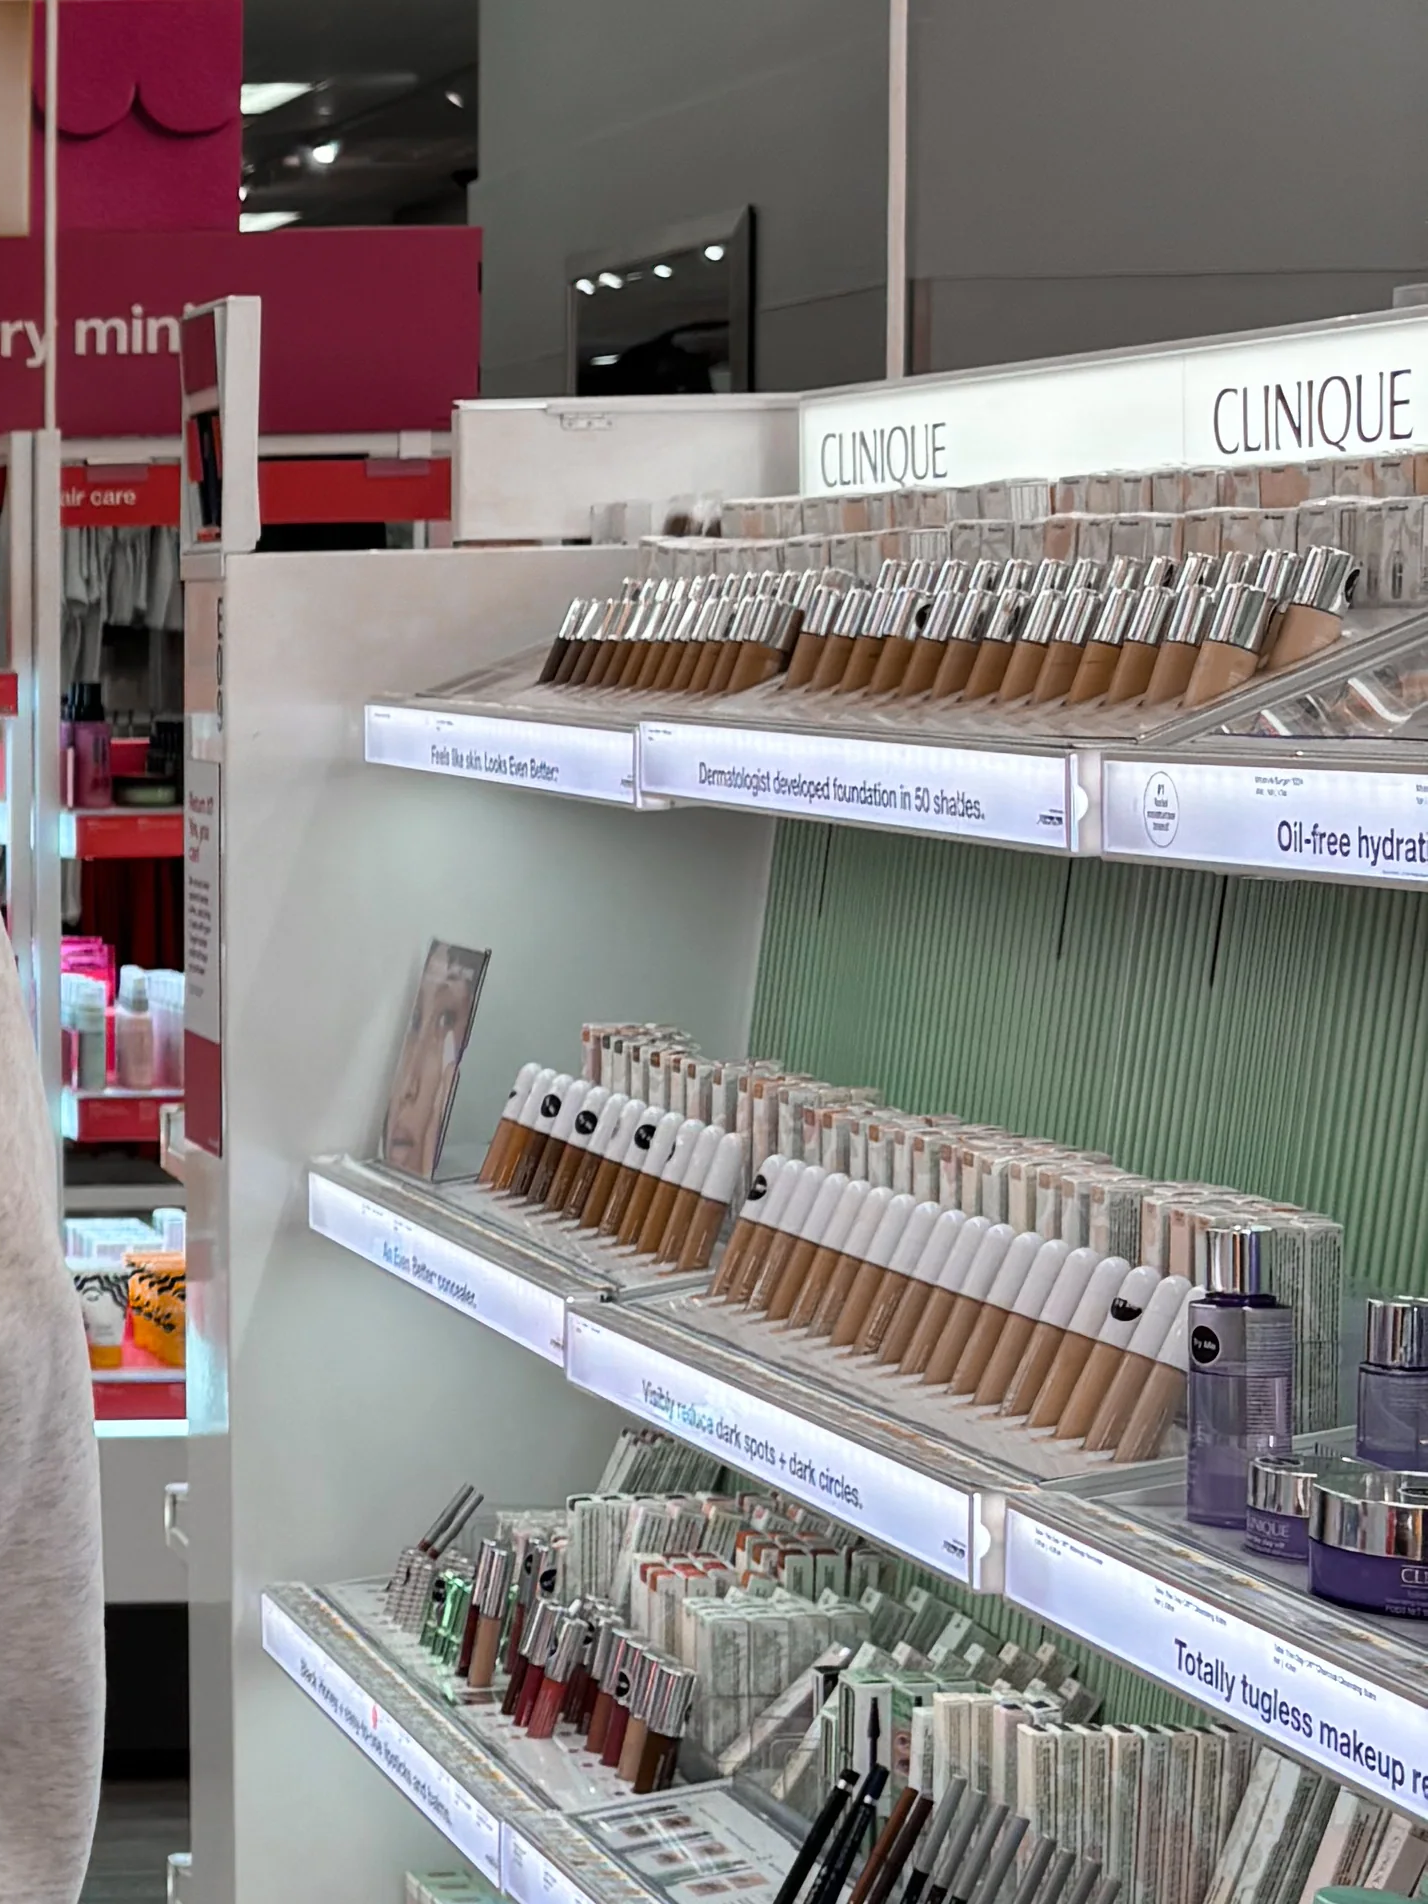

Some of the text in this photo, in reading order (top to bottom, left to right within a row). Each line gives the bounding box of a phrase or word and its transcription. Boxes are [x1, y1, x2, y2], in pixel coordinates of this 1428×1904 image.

[1213, 368, 1414, 454] CLINIQUE
[821, 421, 948, 488] CLINIQUE
[90, 488, 136, 507] care
[484, 752, 508, 776] Looks
[509, 756, 529, 779] Even
[698, 761, 986, 821] Dermatologist developed foundation in 50 shades.
[1277, 819, 1351, 858] Oil-free
[642, 1378, 675, 1420] Visibly
[676, 1400, 714, 1436] reduce
[716, 1418, 742, 1450] dark
[744, 1432, 776, 1465] spots
[789, 1451, 817, 1487] dark
[819, 1466, 863, 1511] circles.
[1173, 1637, 1236, 1703] Totally
[1240, 1674, 1314, 1739] tugless
[1319, 1718, 1406, 1791] makeup
